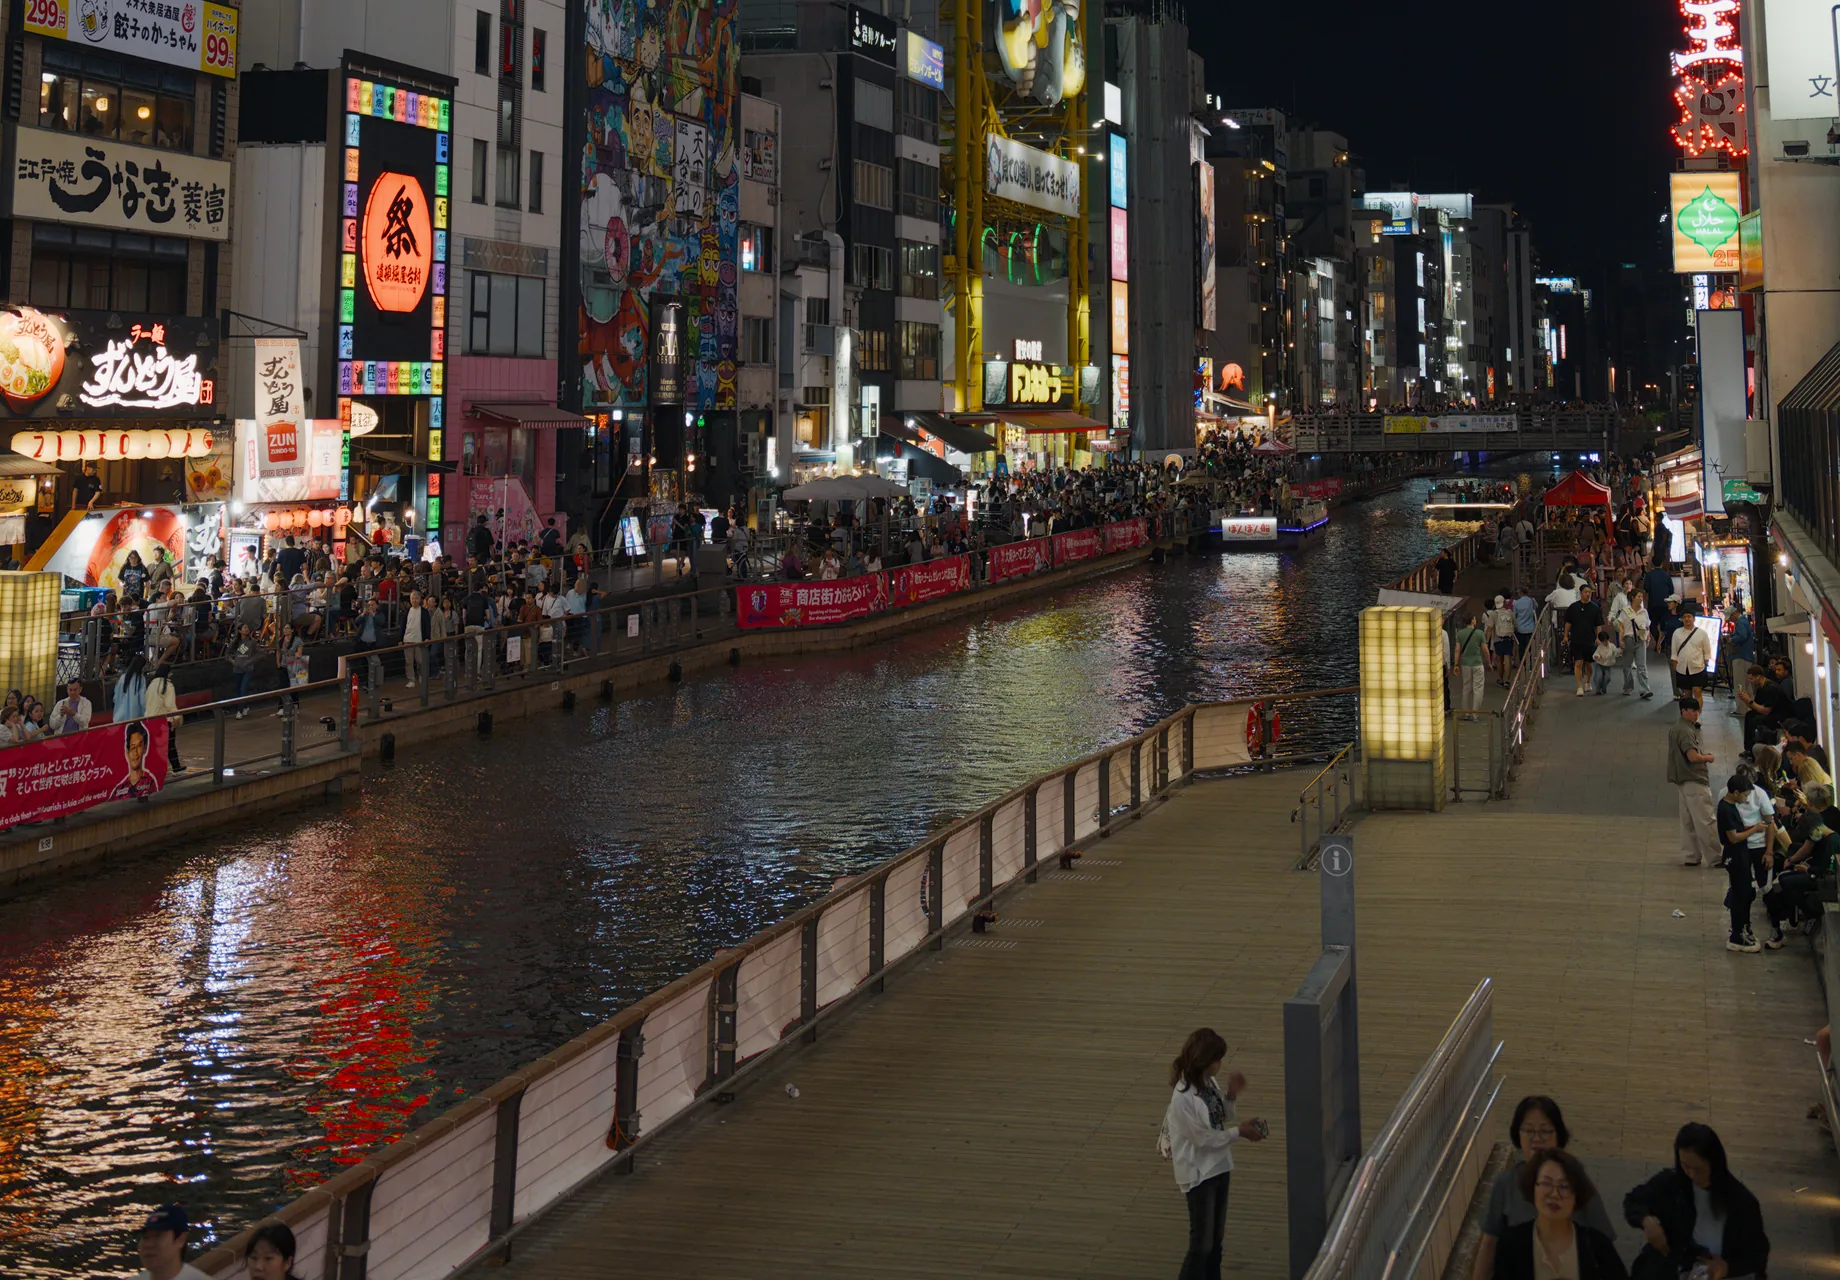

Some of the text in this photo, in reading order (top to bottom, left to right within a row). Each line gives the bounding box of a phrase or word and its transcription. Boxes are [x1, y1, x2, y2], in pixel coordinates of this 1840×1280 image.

[113, 12, 197, 53] 餃子のかっちゃん
[206, 20, 236, 35] ハイボール
[1808, 74, 1838, 98] 文
[18, 146, 225, 225] 江戸焼 うなぎ 菱富
[381, 184, 421, 260] 祭
[1691, 209, 1725, 228] حلال
[1695, 227, 1723, 235] HALAL
[1713, 250, 1740, 267] 2F
[15, 315, 56, 354] ずんどう屋
[656, 332, 679, 356] GALA
[79, 339, 203, 409] ずんどう屋
[656, 356, 681, 365] RESORT
[259, 356, 294, 416] ずんどう屋
[269, 432, 295, 447] ZUN
[17, 753, 95, 780] シンボルとして、アジア、
[16, 765, 113, 796] そして世界で咲き誇るクラブへ
[9, 814, 21, 822] club
[67, 799, 77, 808] Asia
[92, 790, 107, 800] world
